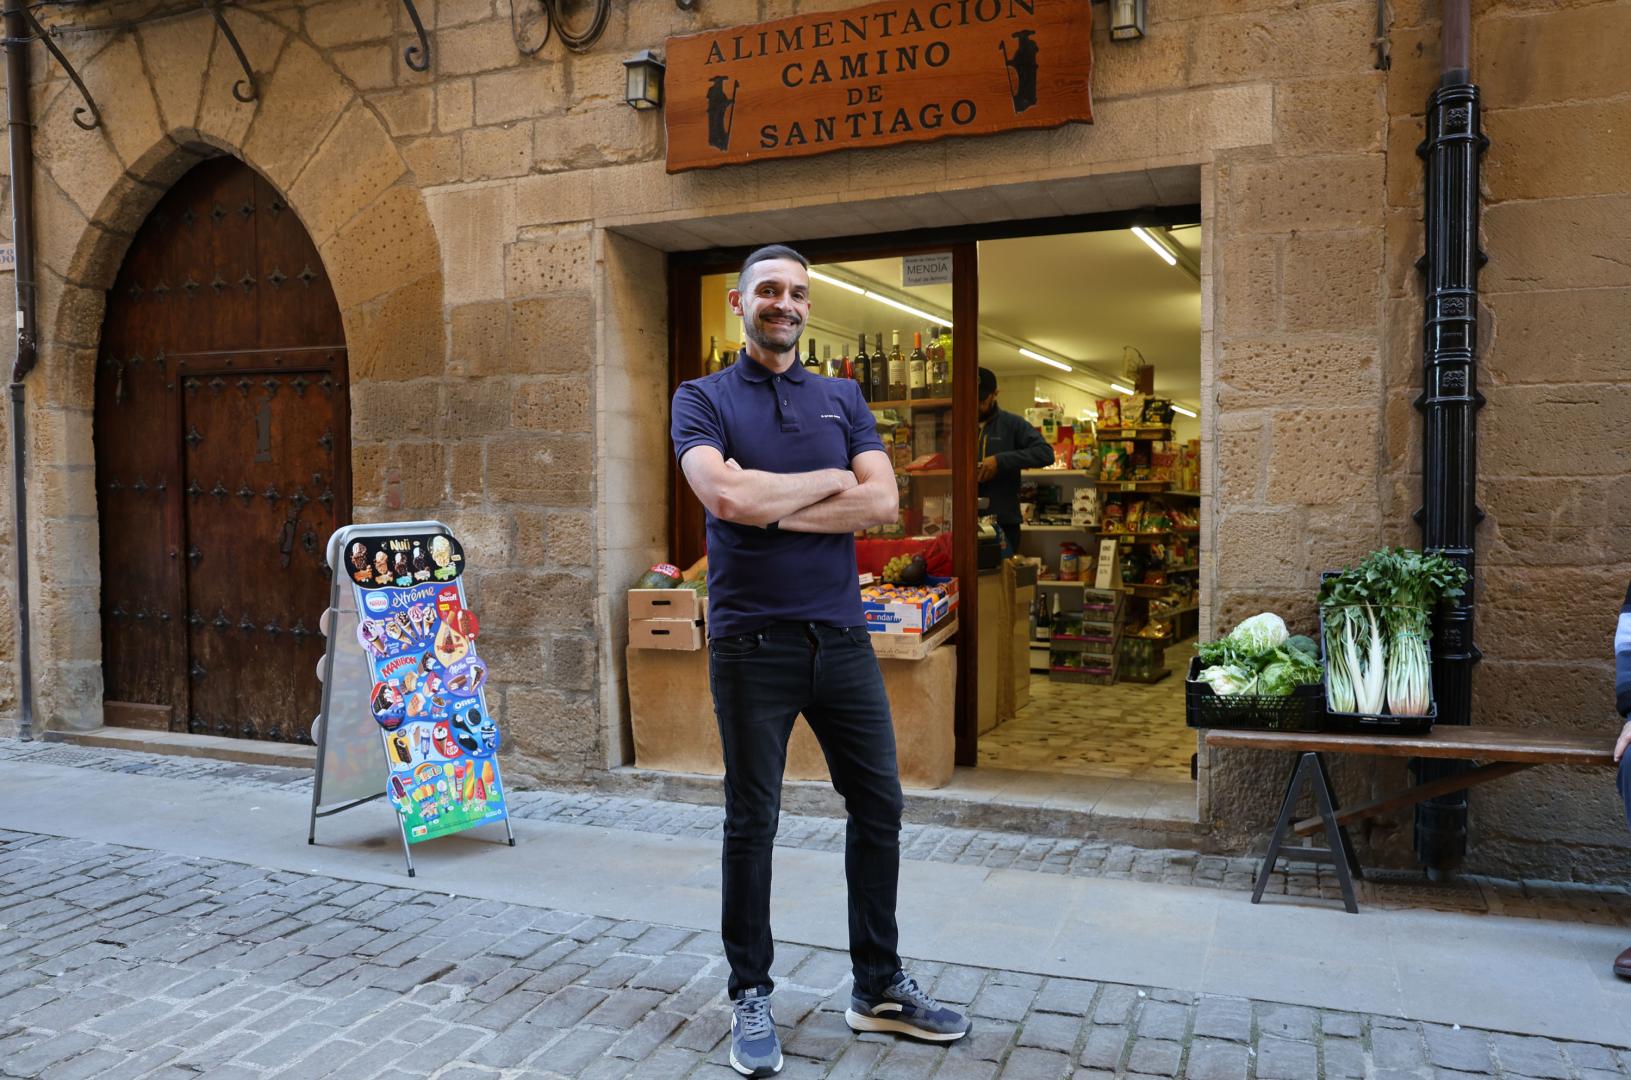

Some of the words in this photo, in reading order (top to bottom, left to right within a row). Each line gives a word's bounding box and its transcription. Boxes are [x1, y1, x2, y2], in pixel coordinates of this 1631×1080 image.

[782, 41, 950, 87] CAMINO
[847, 85, 884, 106] DE
[760, 99, 977, 149] SANTIAGO
